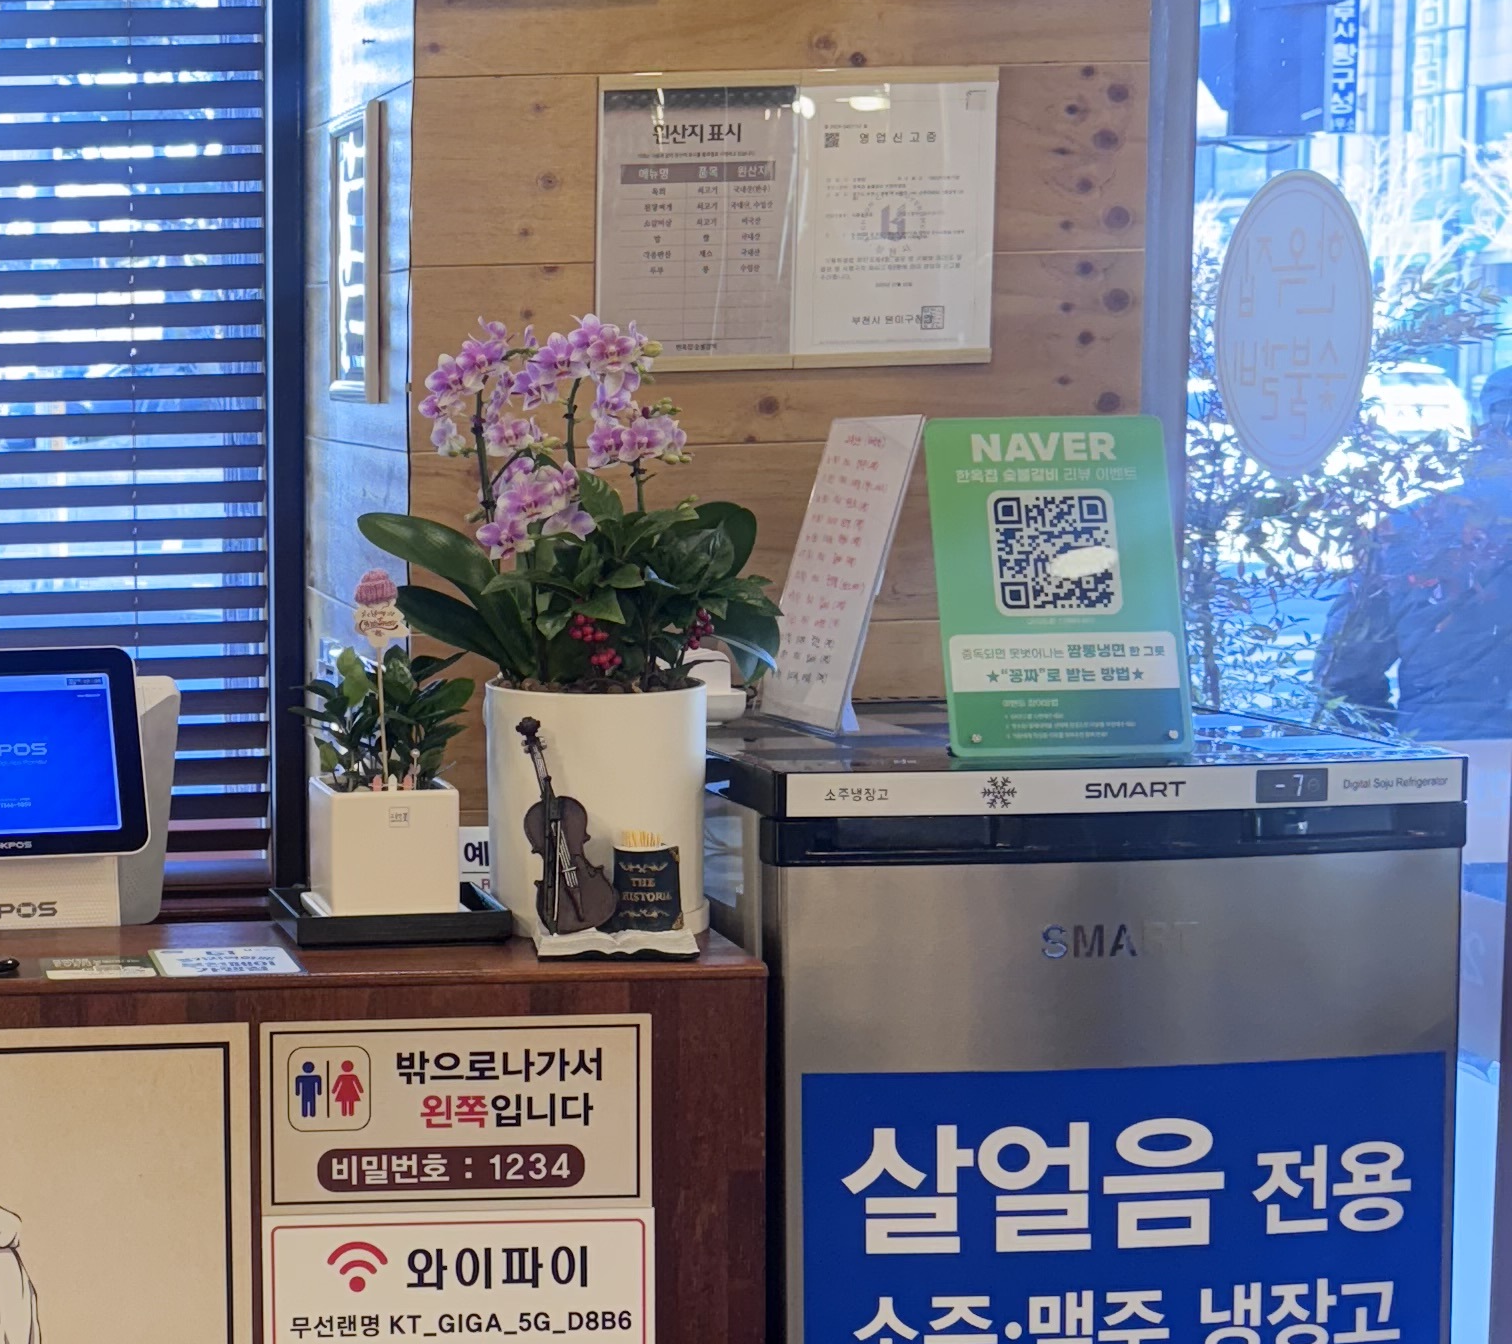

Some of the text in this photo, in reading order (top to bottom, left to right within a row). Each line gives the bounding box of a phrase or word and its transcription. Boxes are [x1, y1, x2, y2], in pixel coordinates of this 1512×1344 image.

[652, 122, 742, 144] 원산지 표시
[971, 431, 1118, 463] NAVER
[956, 469, 998, 483] 한옥집
[1063, 467, 1091, 481] 리뷰
[1095, 466, 1138, 481] 이벤트
[824, 787, 889, 802] 소주냉장고
[1085, 781, 1186, 799] SMART
[1343, 776, 1448, 791] Digital Soju Refrigerator
[630, 878, 655, 887] THE
[1042, 923, 1199, 959] SMA
[396, 1047, 603, 1085] 밖으로나가서
[420, 1092, 594, 1129] 왼쪽입니다
[331, 1154, 450, 1186] 비밀번호
[489, 1152, 572, 1181] 1234
[840, 1116, 1412, 1255] 살얼음 전용
[406, 1245, 589, 1291] 와이파이
[289, 1310, 633, 1340] 무선랜명 KT_GIGA_5G_D8B6
